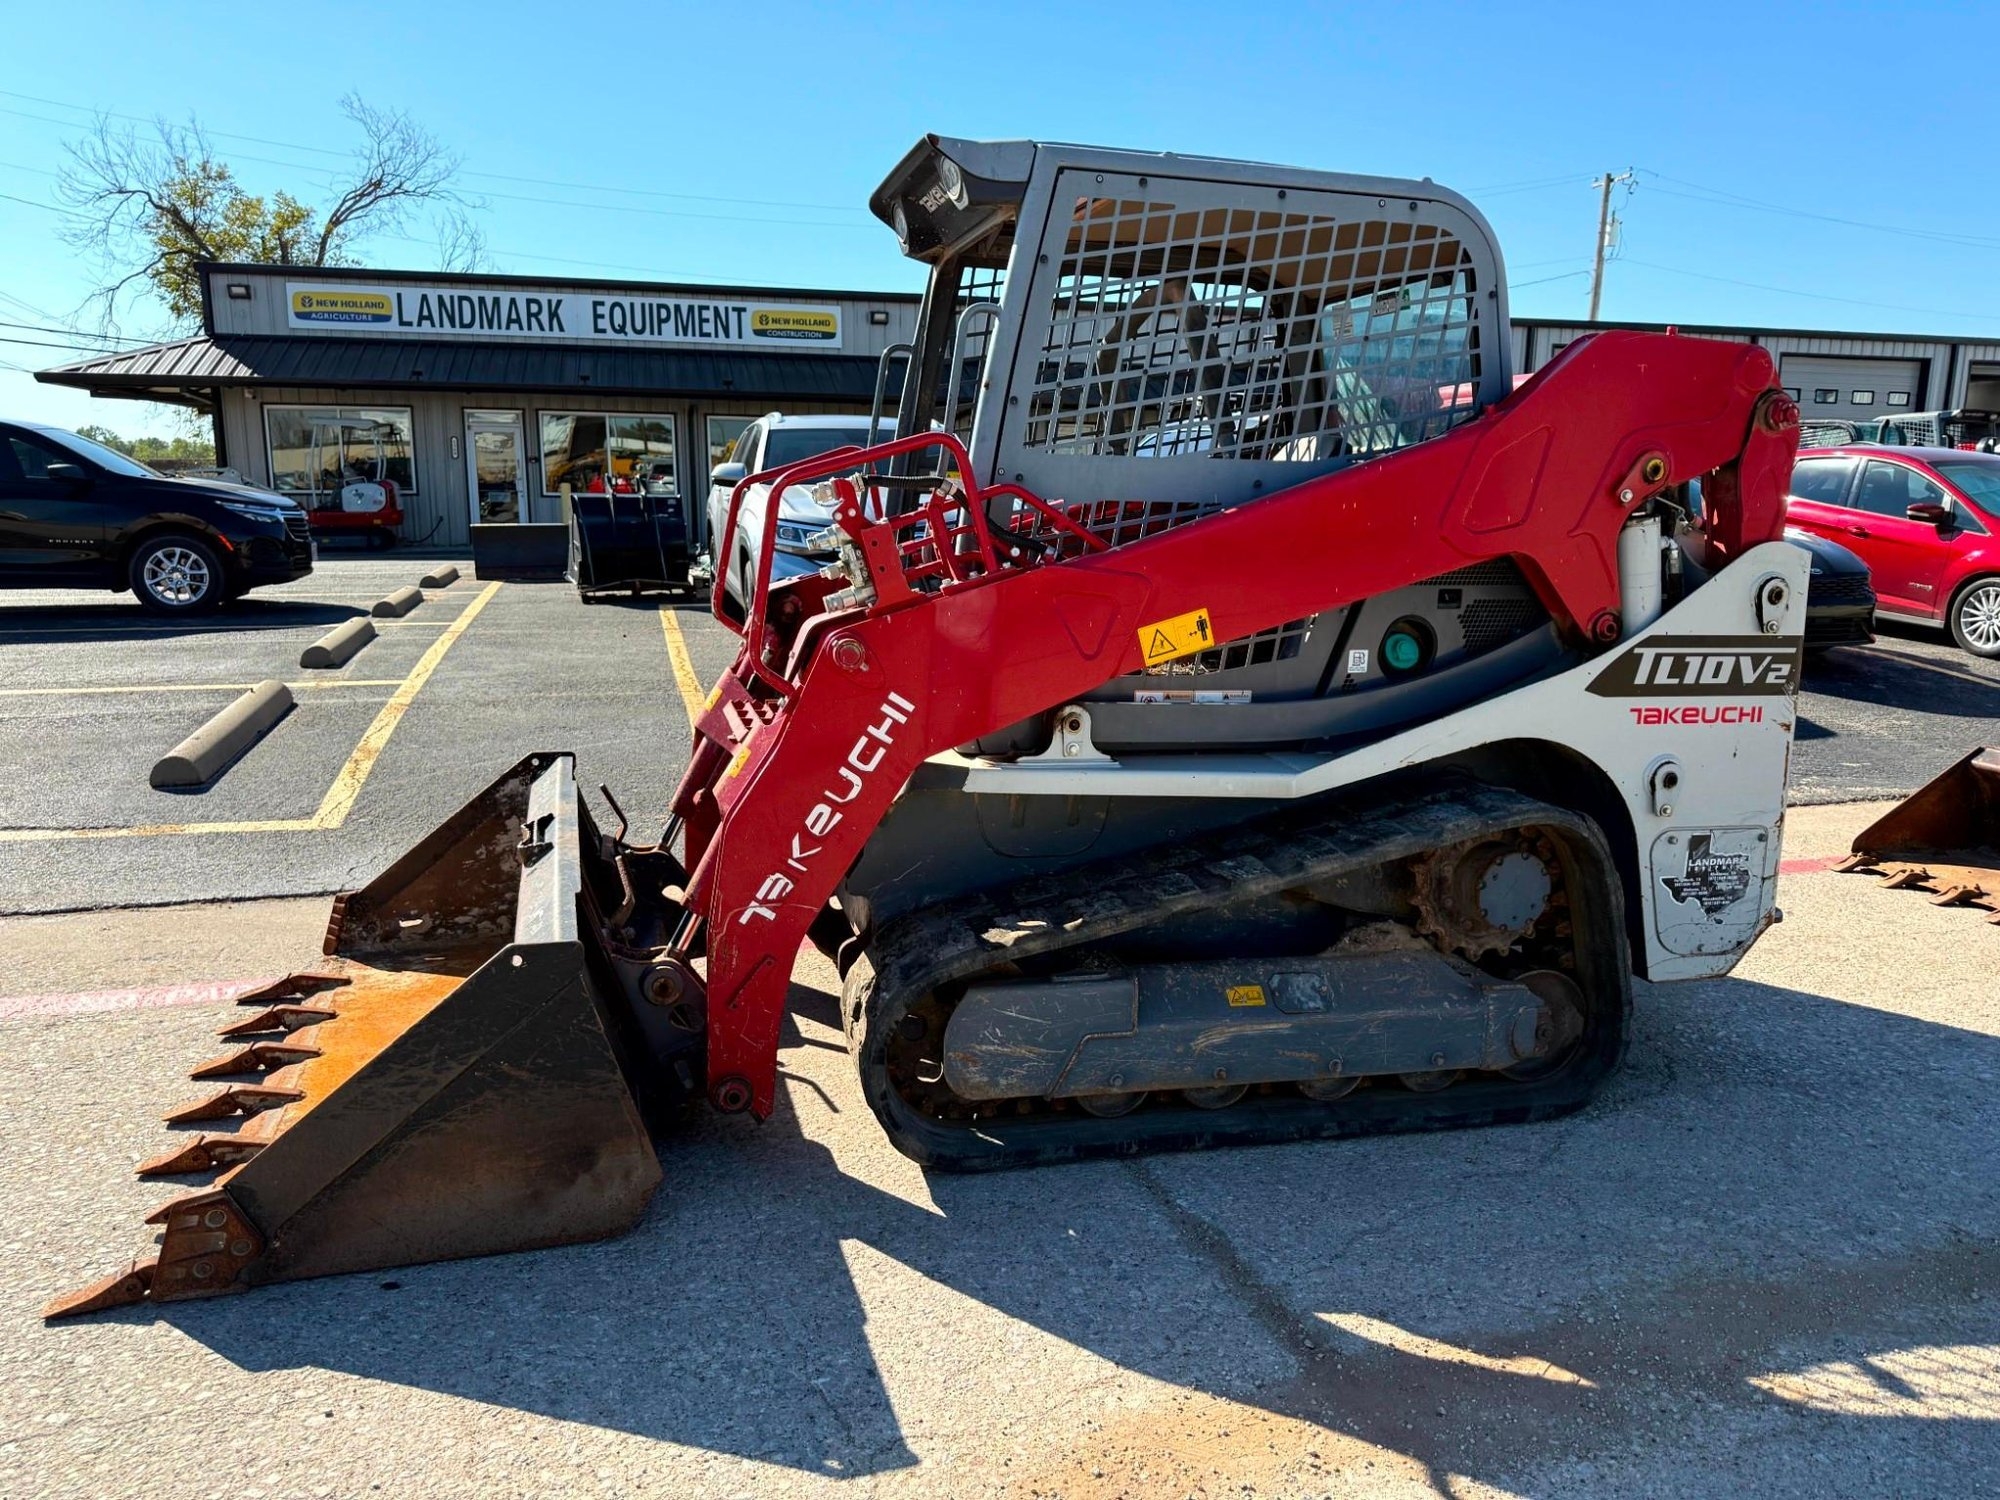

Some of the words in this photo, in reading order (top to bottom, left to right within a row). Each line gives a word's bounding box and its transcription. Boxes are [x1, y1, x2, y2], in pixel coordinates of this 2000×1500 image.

[315, 299, 338, 309] NEW
[340, 300, 385, 310] HOLLAND
[310, 312, 373, 321] AGRICULTURE
[396, 291, 566, 333] LANDMARK
[592, 300, 747, 340] EQUIPMENT
[771, 317, 790, 326] NEW
[791, 318, 831, 328] HOLLAND
[766, 329, 823, 339] CONSTRUCTION
[1629, 706, 1763, 725] TAKEUCHI
[738, 691, 916, 926] TAKEUCHI
